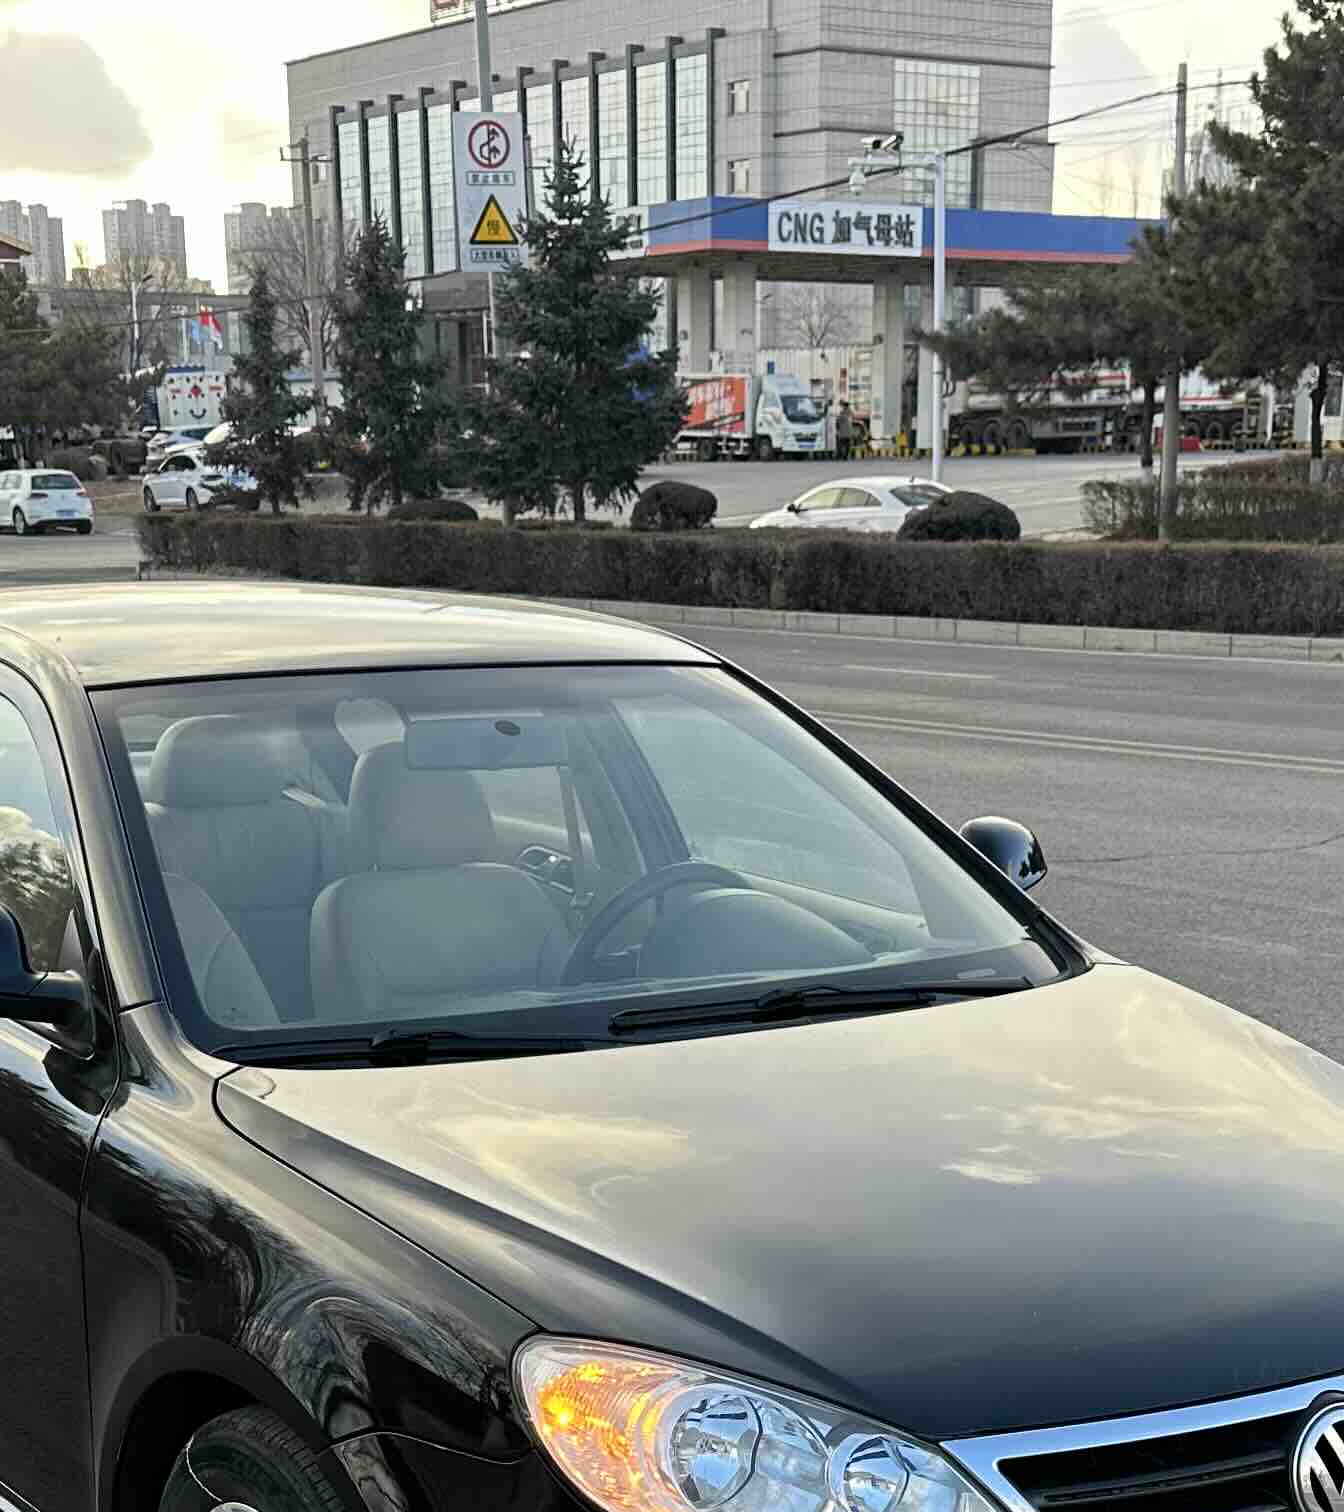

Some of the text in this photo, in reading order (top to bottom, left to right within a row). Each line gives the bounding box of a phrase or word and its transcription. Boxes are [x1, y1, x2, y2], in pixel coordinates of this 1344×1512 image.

[778, 209, 915, 248] CNG 加气母站
